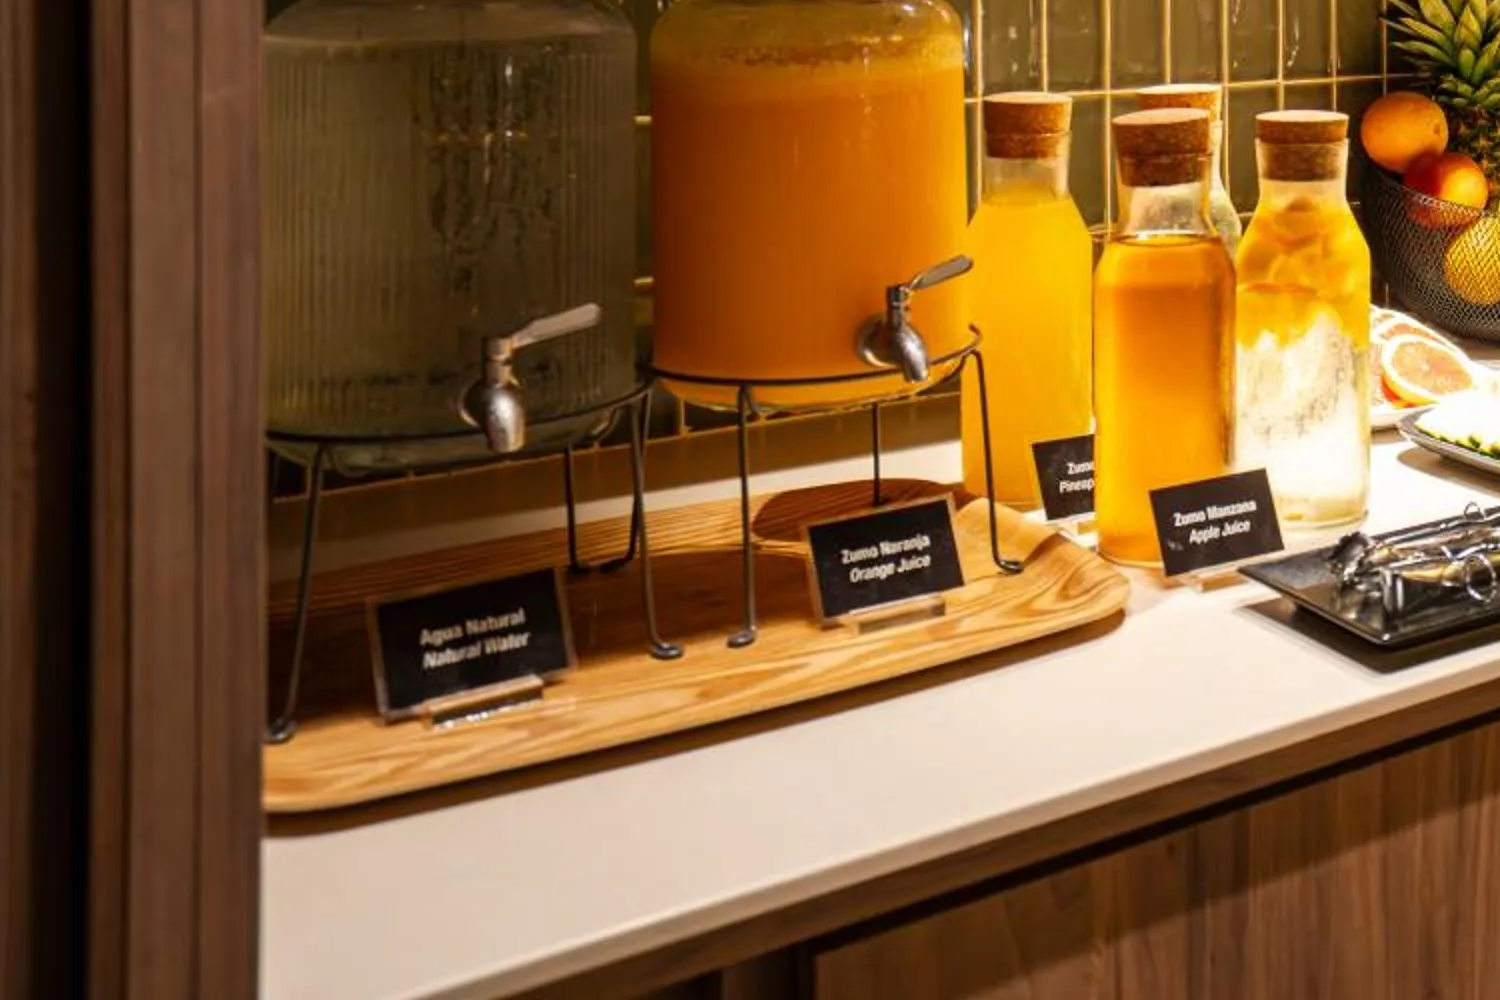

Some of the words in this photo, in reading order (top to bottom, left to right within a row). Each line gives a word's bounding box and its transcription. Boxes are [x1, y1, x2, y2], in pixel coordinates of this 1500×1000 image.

[1173, 510, 1206, 528] Zumo
[1206, 500, 1257, 520] Manzana
[1189, 525, 1220, 545] Apple
[1221, 519, 1252, 537] Juice
[841, 546, 879, 565] Zumo
[879, 533, 931, 556] Naranja
[849, 563, 896, 583] Orange
[897, 554, 931, 573] Juice
[420, 625, 463, 647] Agua
[465, 606, 526, 635] Natural
[423, 641, 481, 669] Natural
[484, 631, 531, 655] Water
